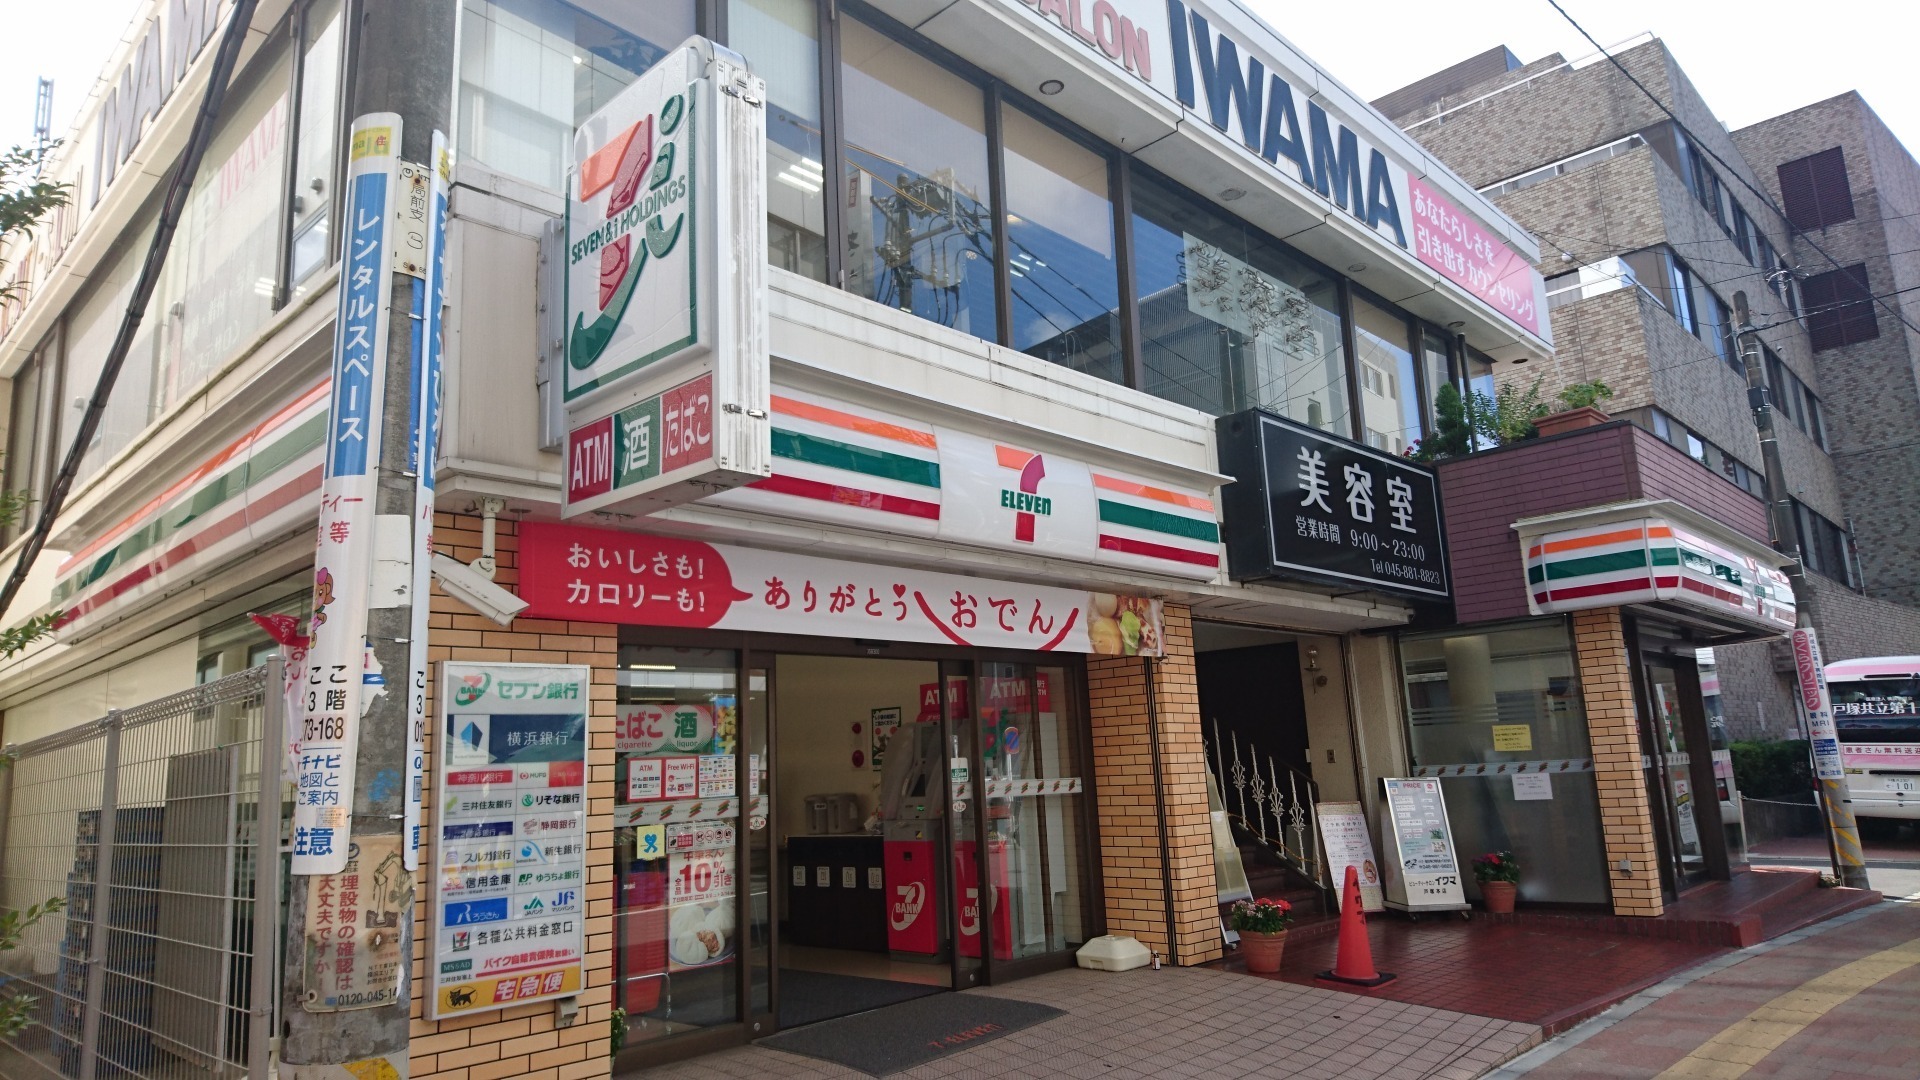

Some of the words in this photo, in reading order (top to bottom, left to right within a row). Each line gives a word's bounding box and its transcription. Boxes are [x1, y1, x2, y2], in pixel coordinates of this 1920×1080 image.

[1167, 0, 1408, 250] IWAMA
[571, 227, 604, 265] SEVEN
[620, 174, 686, 235] HOLDINGS
[1413, 188, 1496, 268] あなたらしさを
[1416, 223, 1534, 322] 引き出すカウンセリング
[339, 208, 381, 443] レンタルスペース
[664, 394, 711, 459] たばこ
[622, 415, 651, 477] 酒
[572, 431, 609, 491] ATM
[1000, 488, 1053, 516] ELEVEN
[1296, 445, 1418, 534] 美容室
[1295, 515, 1341, 545] 営業時間
[566, 542, 705, 580] おいしさも!
[1370, 558, 1384, 574] Tel
[1385, 562, 1441, 585] 045-881-8823
[566, 578, 706, 612] カロリーも!
[764, 575, 908, 621] ありがとう
[949, 589, 1055, 636] おでん
[497, 680, 579, 700] セブン銀行
[989, 680, 1026, 699] ATM
[1832, 701, 1916, 715] 戸塚共立第1
[506, 731, 569, 747] 横浜銀行
[674, 711, 698, 739] 酒
[617, 741, 653, 750] cigarette
[676, 740, 698, 748] liquor
[639, 764, 653, 772] ATM
[461, 799, 513, 811] 三井住友銀行
[536, 793, 580, 806] りそな銀行
[544, 843, 582, 857] 新生銀行
[465, 873, 512, 889] 信用金庫
[536, 869, 580, 883] ゆうちょ銀行
[895, 902, 919, 914] BANK
[335, 874, 359, 991] 埋設物の確認は
[477, 921, 573, 946] 各種公共料金窓口
[496, 971, 564, 1001] 宅急便
